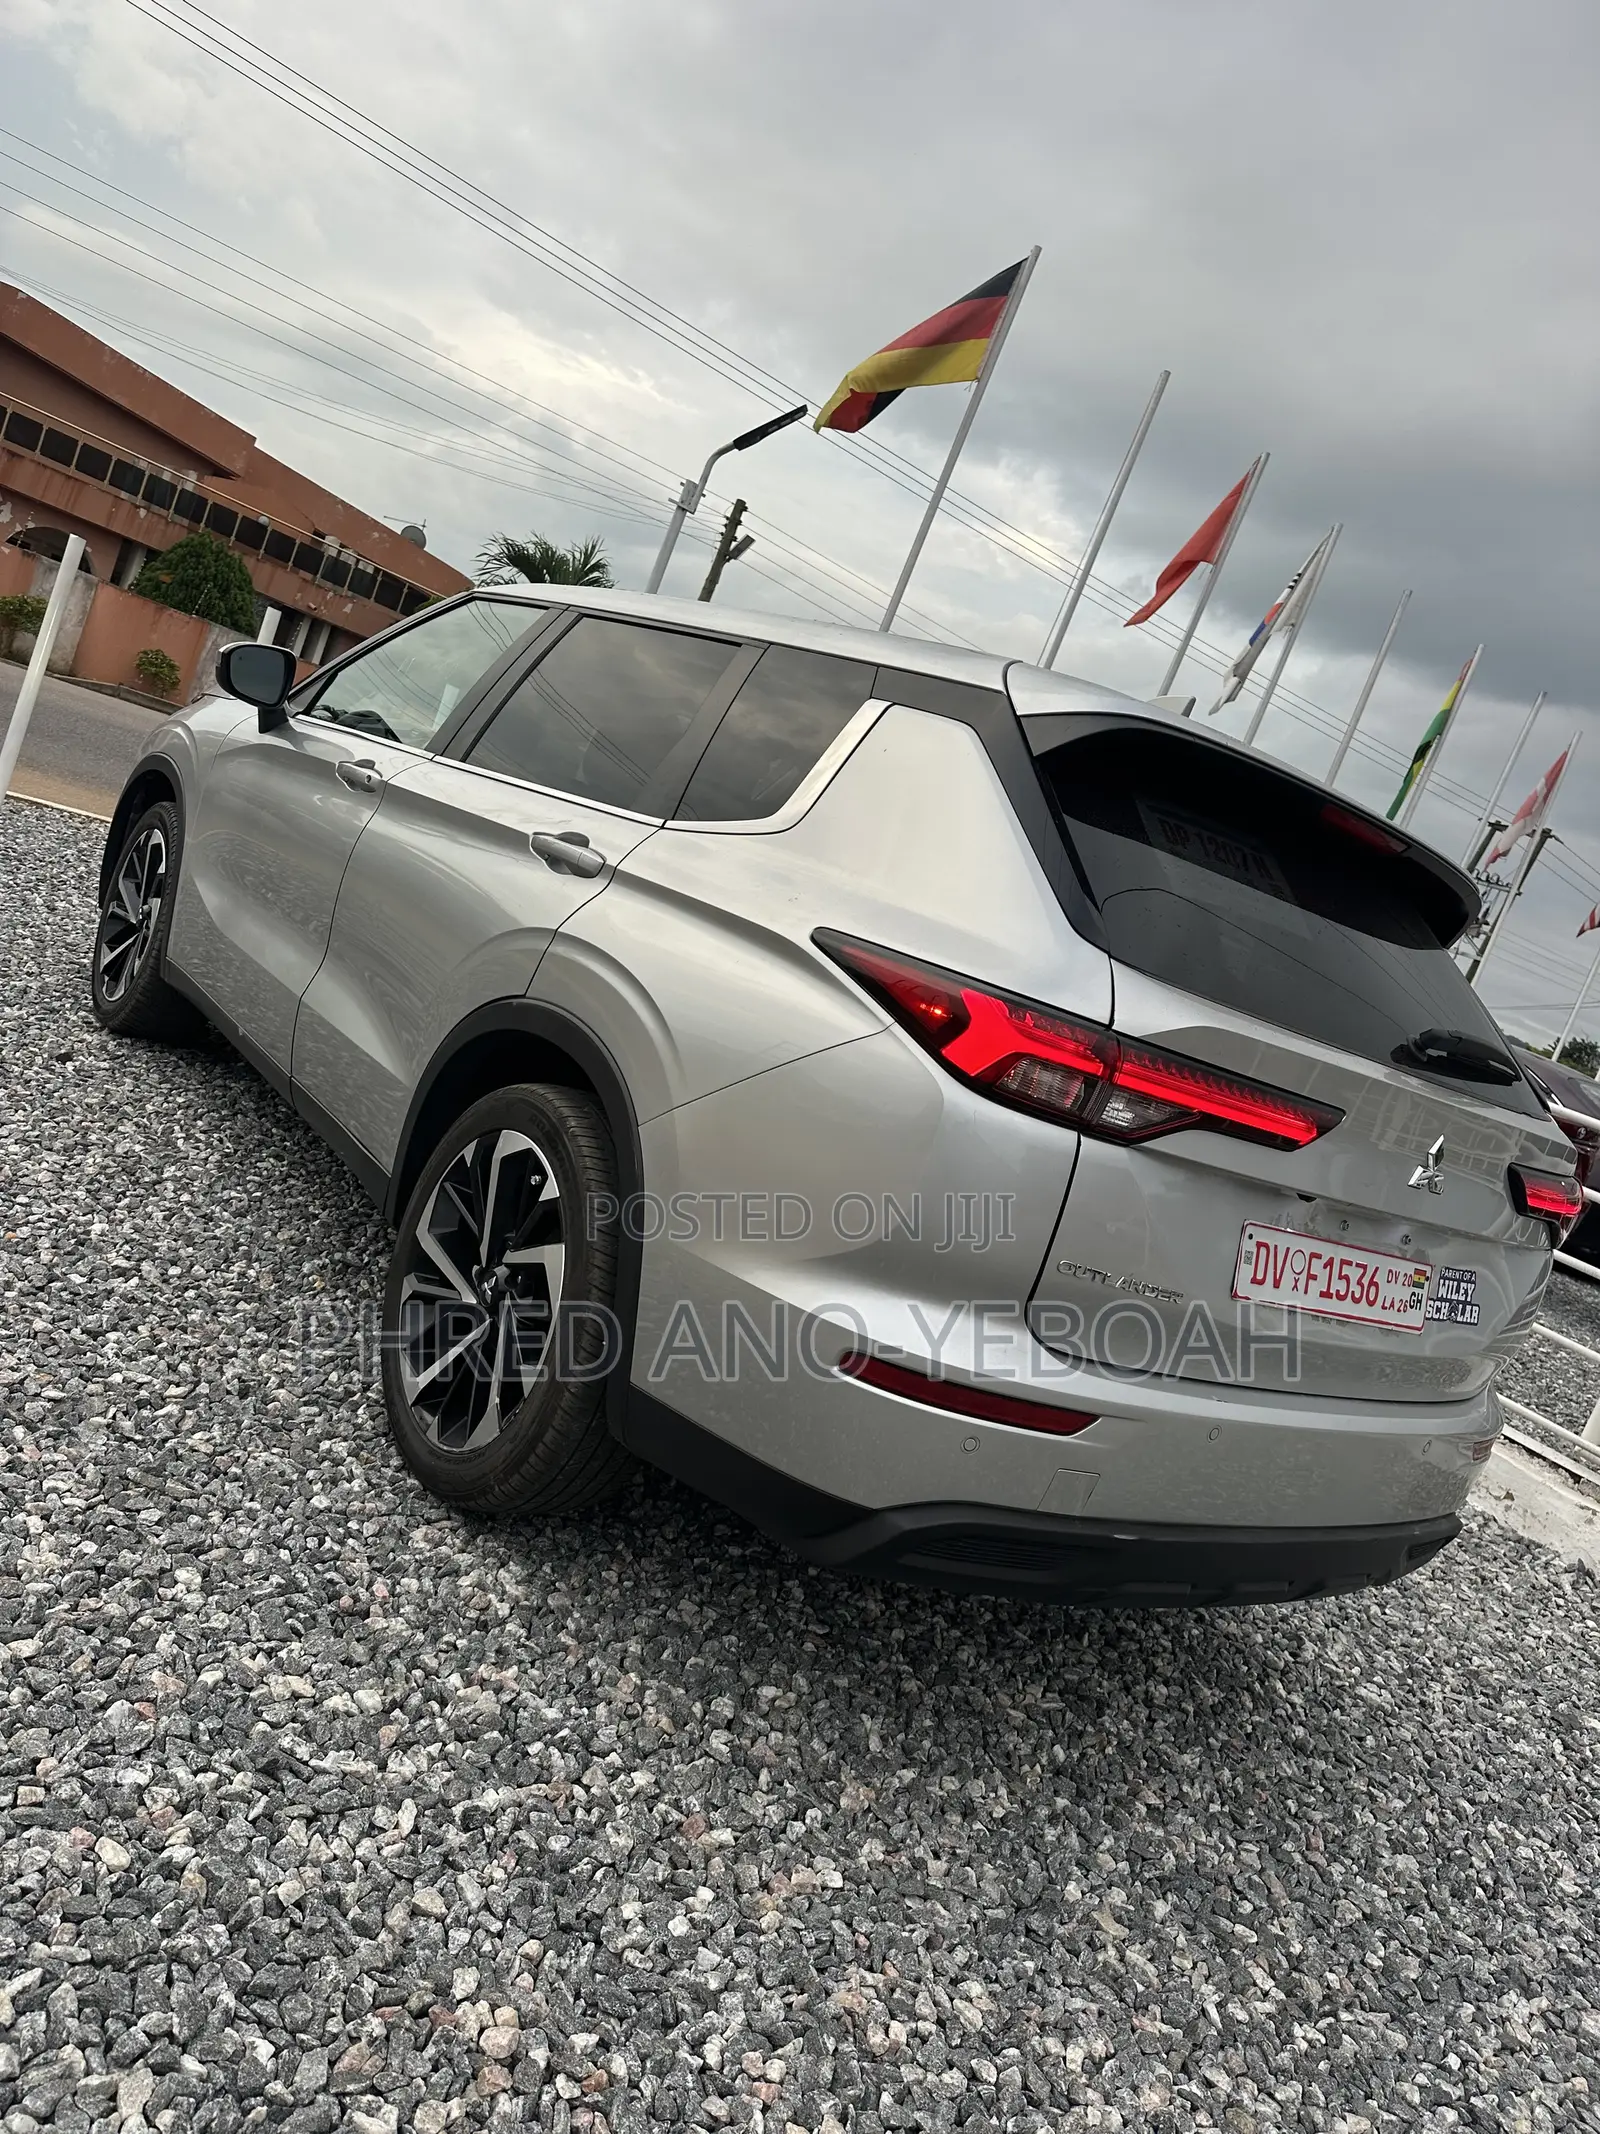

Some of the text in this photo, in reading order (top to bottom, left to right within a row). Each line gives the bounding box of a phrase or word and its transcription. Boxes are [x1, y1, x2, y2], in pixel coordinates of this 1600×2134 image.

[1057, 1260, 1184, 1304] OUTLANDER
[1250, 1241, 1290, 1288] DV
[1303, 1252, 1380, 1307] F1536
[1386, 1269, 1400, 1284] DV
[1441, 1269, 1463, 1279] PARENT
[1409, 1291, 1423, 1310] GH
[1438, 1279, 1475, 1302] WILEY
[1381, 1296, 1395, 1310] LA
[1426, 1301, 1480, 1324] SCHLAR
